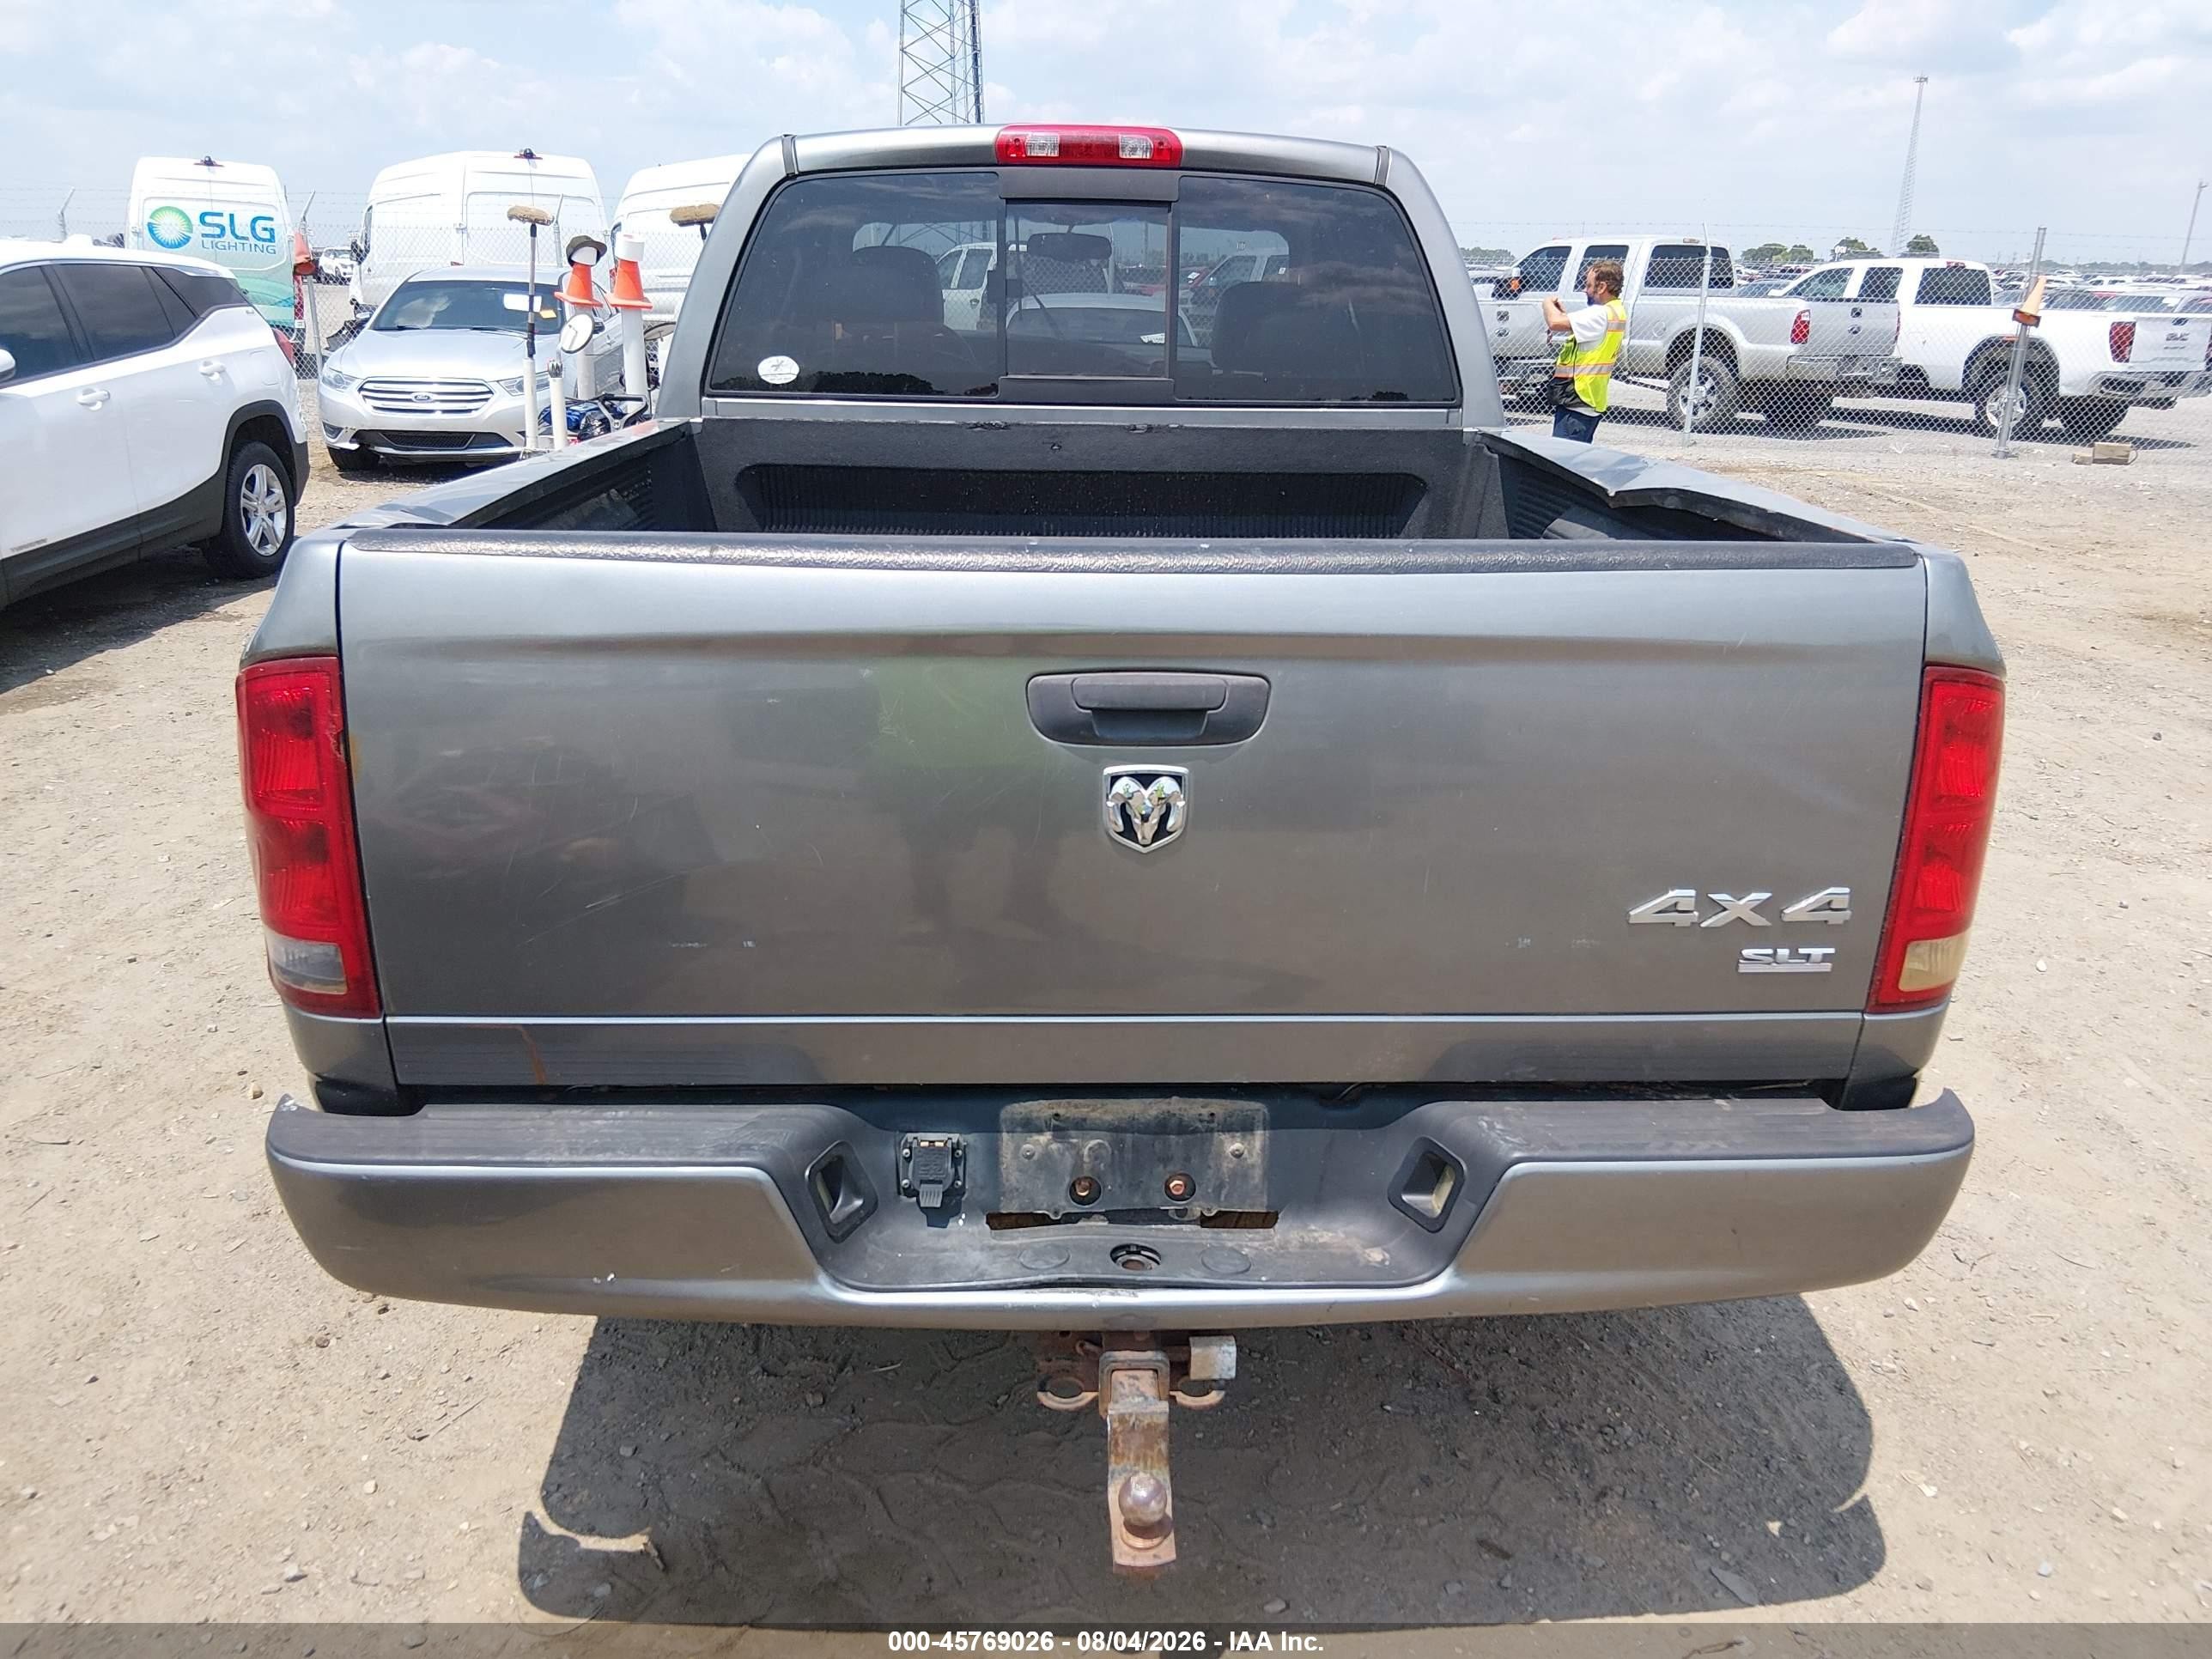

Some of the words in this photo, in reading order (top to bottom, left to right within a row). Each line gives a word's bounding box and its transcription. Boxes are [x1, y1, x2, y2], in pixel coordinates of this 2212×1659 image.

[199, 211, 276, 243] SLG
[201, 240, 276, 255] LIGHTING
[1738, 947, 1836, 964] SLT
